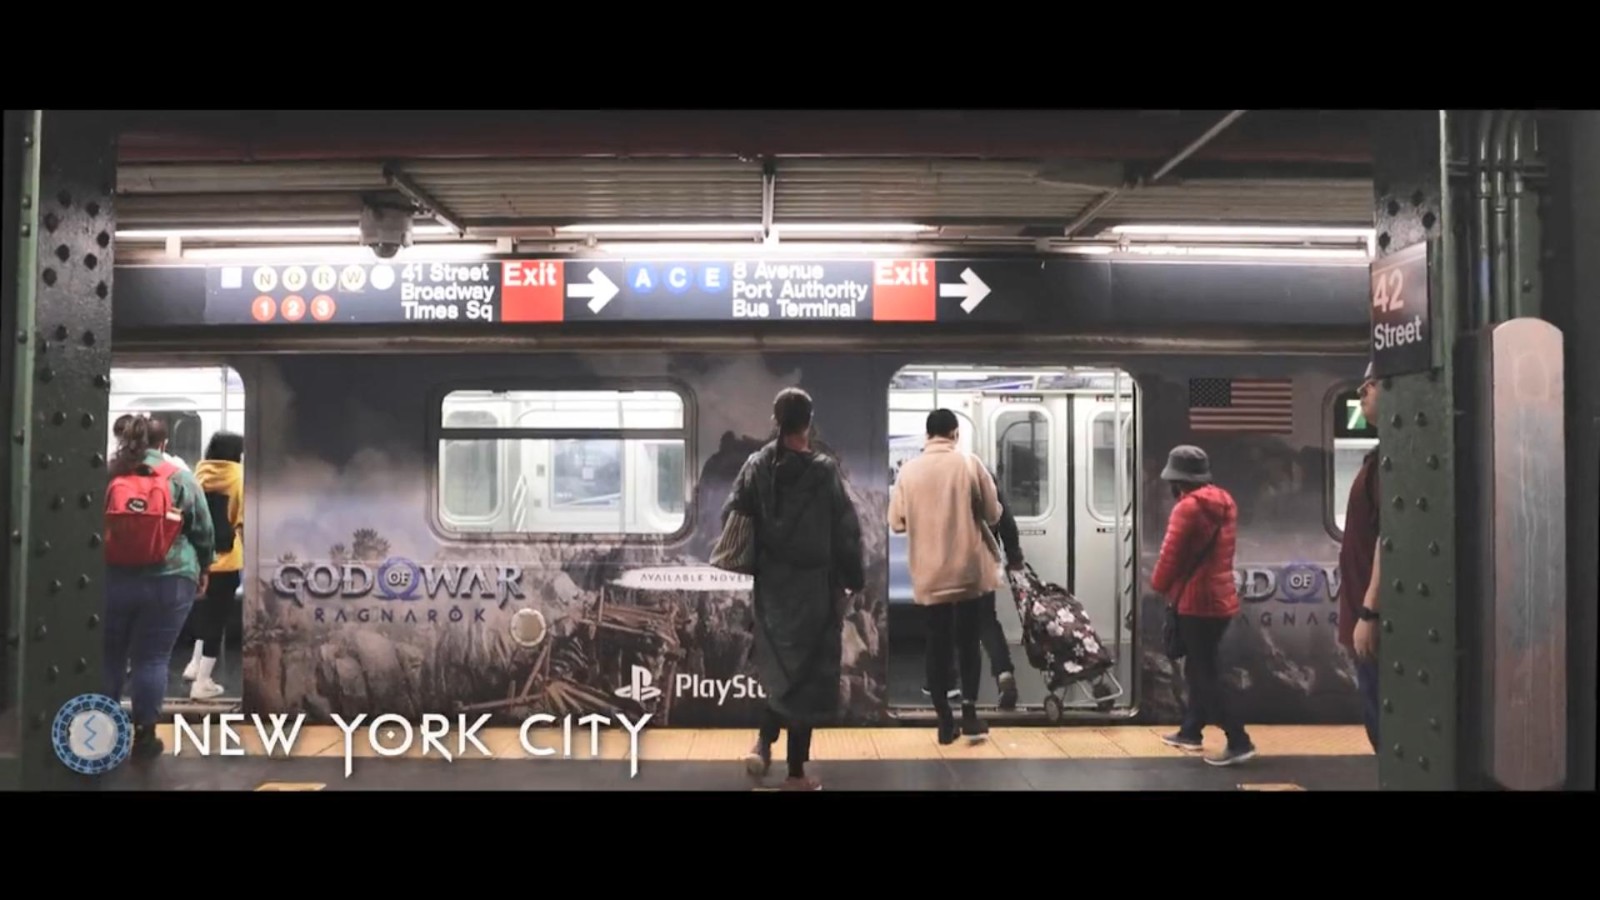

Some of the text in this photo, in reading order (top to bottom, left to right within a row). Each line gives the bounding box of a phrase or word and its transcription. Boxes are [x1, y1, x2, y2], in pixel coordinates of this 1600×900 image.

[259, 272, 271, 286] N
[318, 271, 330, 285] R
[346, 270, 362, 285] W
[401, 263, 489, 282] 41 Street
[504, 262, 557, 286] Exit
[635, 269, 720, 286] A C E
[733, 262, 824, 279] 8 Avenue
[876, 262, 929, 285] Exit
[401, 282, 495, 303] Broadway
[733, 281, 868, 302] Port Authority
[1373, 268, 1405, 313] 42
[260, 302, 330, 316] 1 2 3
[402, 302, 493, 322] Times Sq
[733, 300, 856, 317] Bus Terminal
[1374, 315, 1423, 350] Street
[273, 563, 526, 608] GOD OF WAR
[640, 573, 704, 582] AVAILABLE
[1290, 574, 1312, 590] OF
